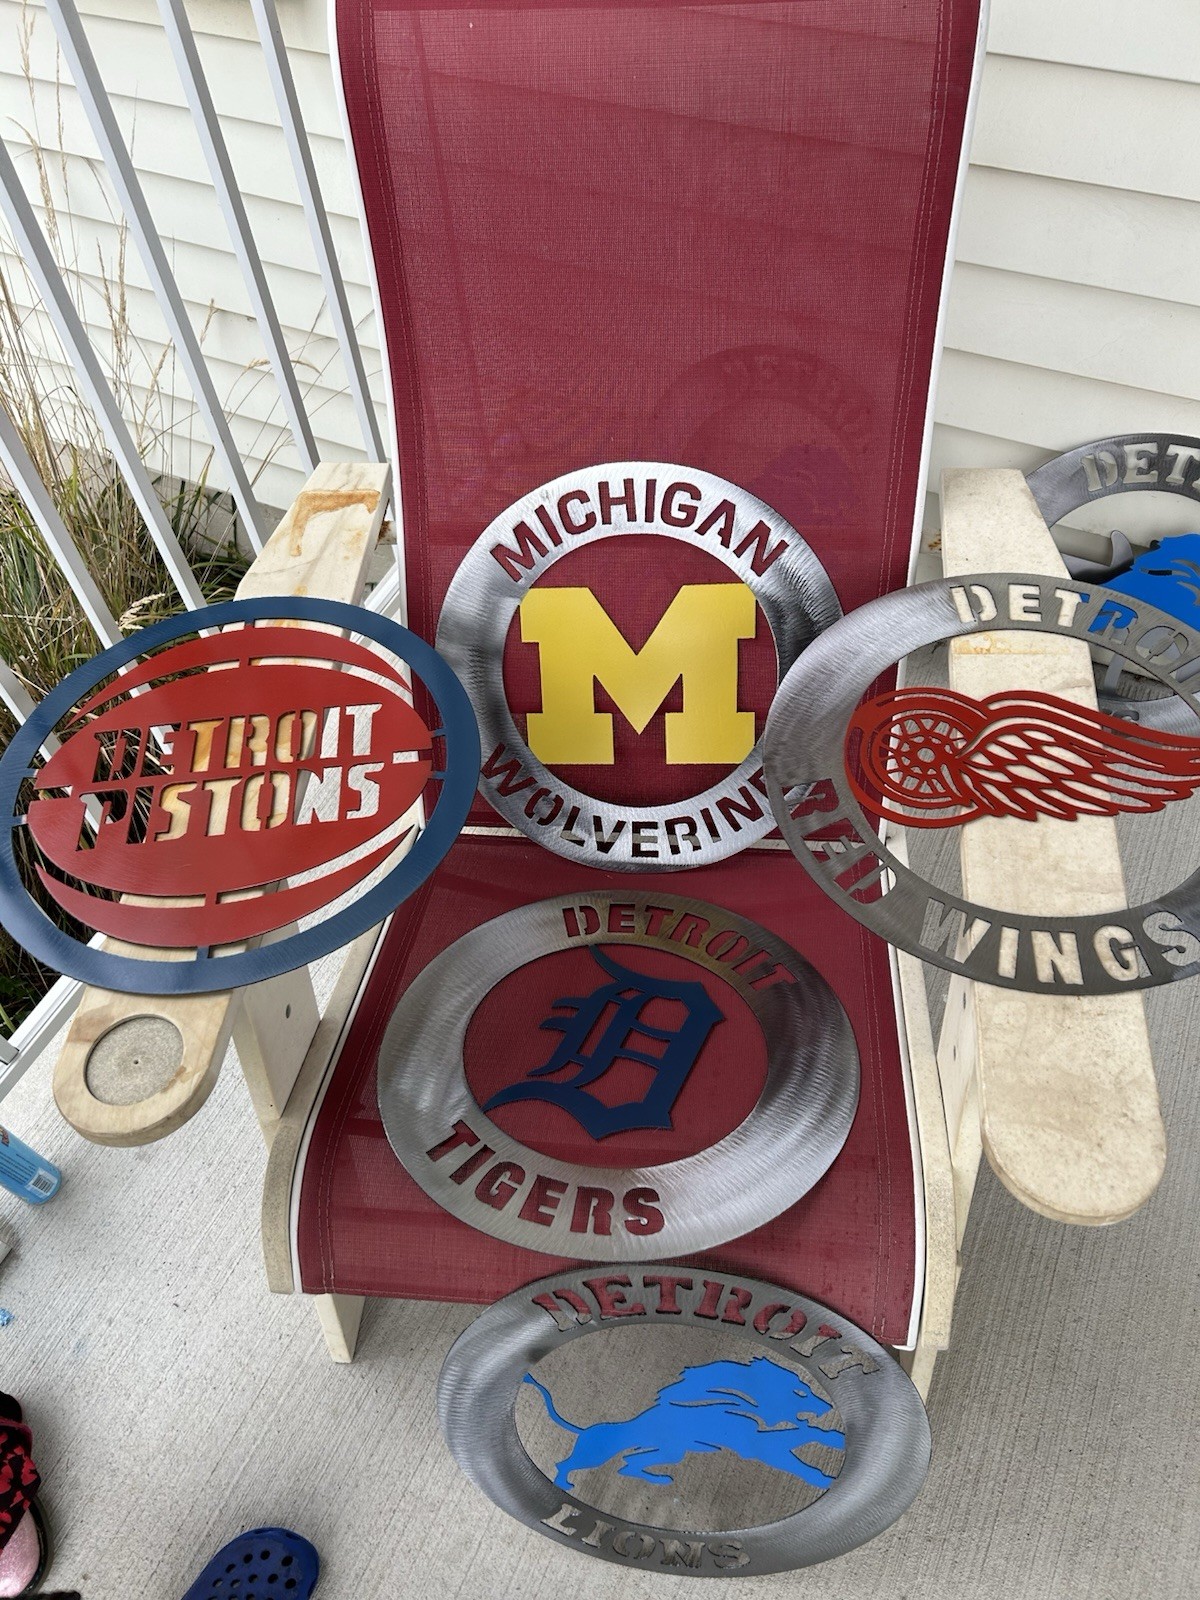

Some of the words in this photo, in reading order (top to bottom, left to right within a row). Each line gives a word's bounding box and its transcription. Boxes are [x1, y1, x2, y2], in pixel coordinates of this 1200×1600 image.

[1081, 442, 1200, 492] DET
[489, 478, 789, 582] MICHIGAN
[519, 583, 757, 765] M
[950, 582, 1200, 702] DETROI
[94, 703, 382, 784] DETROIT
[75, 763, 385, 852] PISTONS
[781, 778, 897, 904] RED
[918, 898, 1200, 985] WINGS
[561, 903, 799, 990] DETROIT
[425, 1119, 666, 1236] TIGERS
[531, 1274, 880, 1380] DETROIT
[540, 1502, 752, 1569] LIONS
